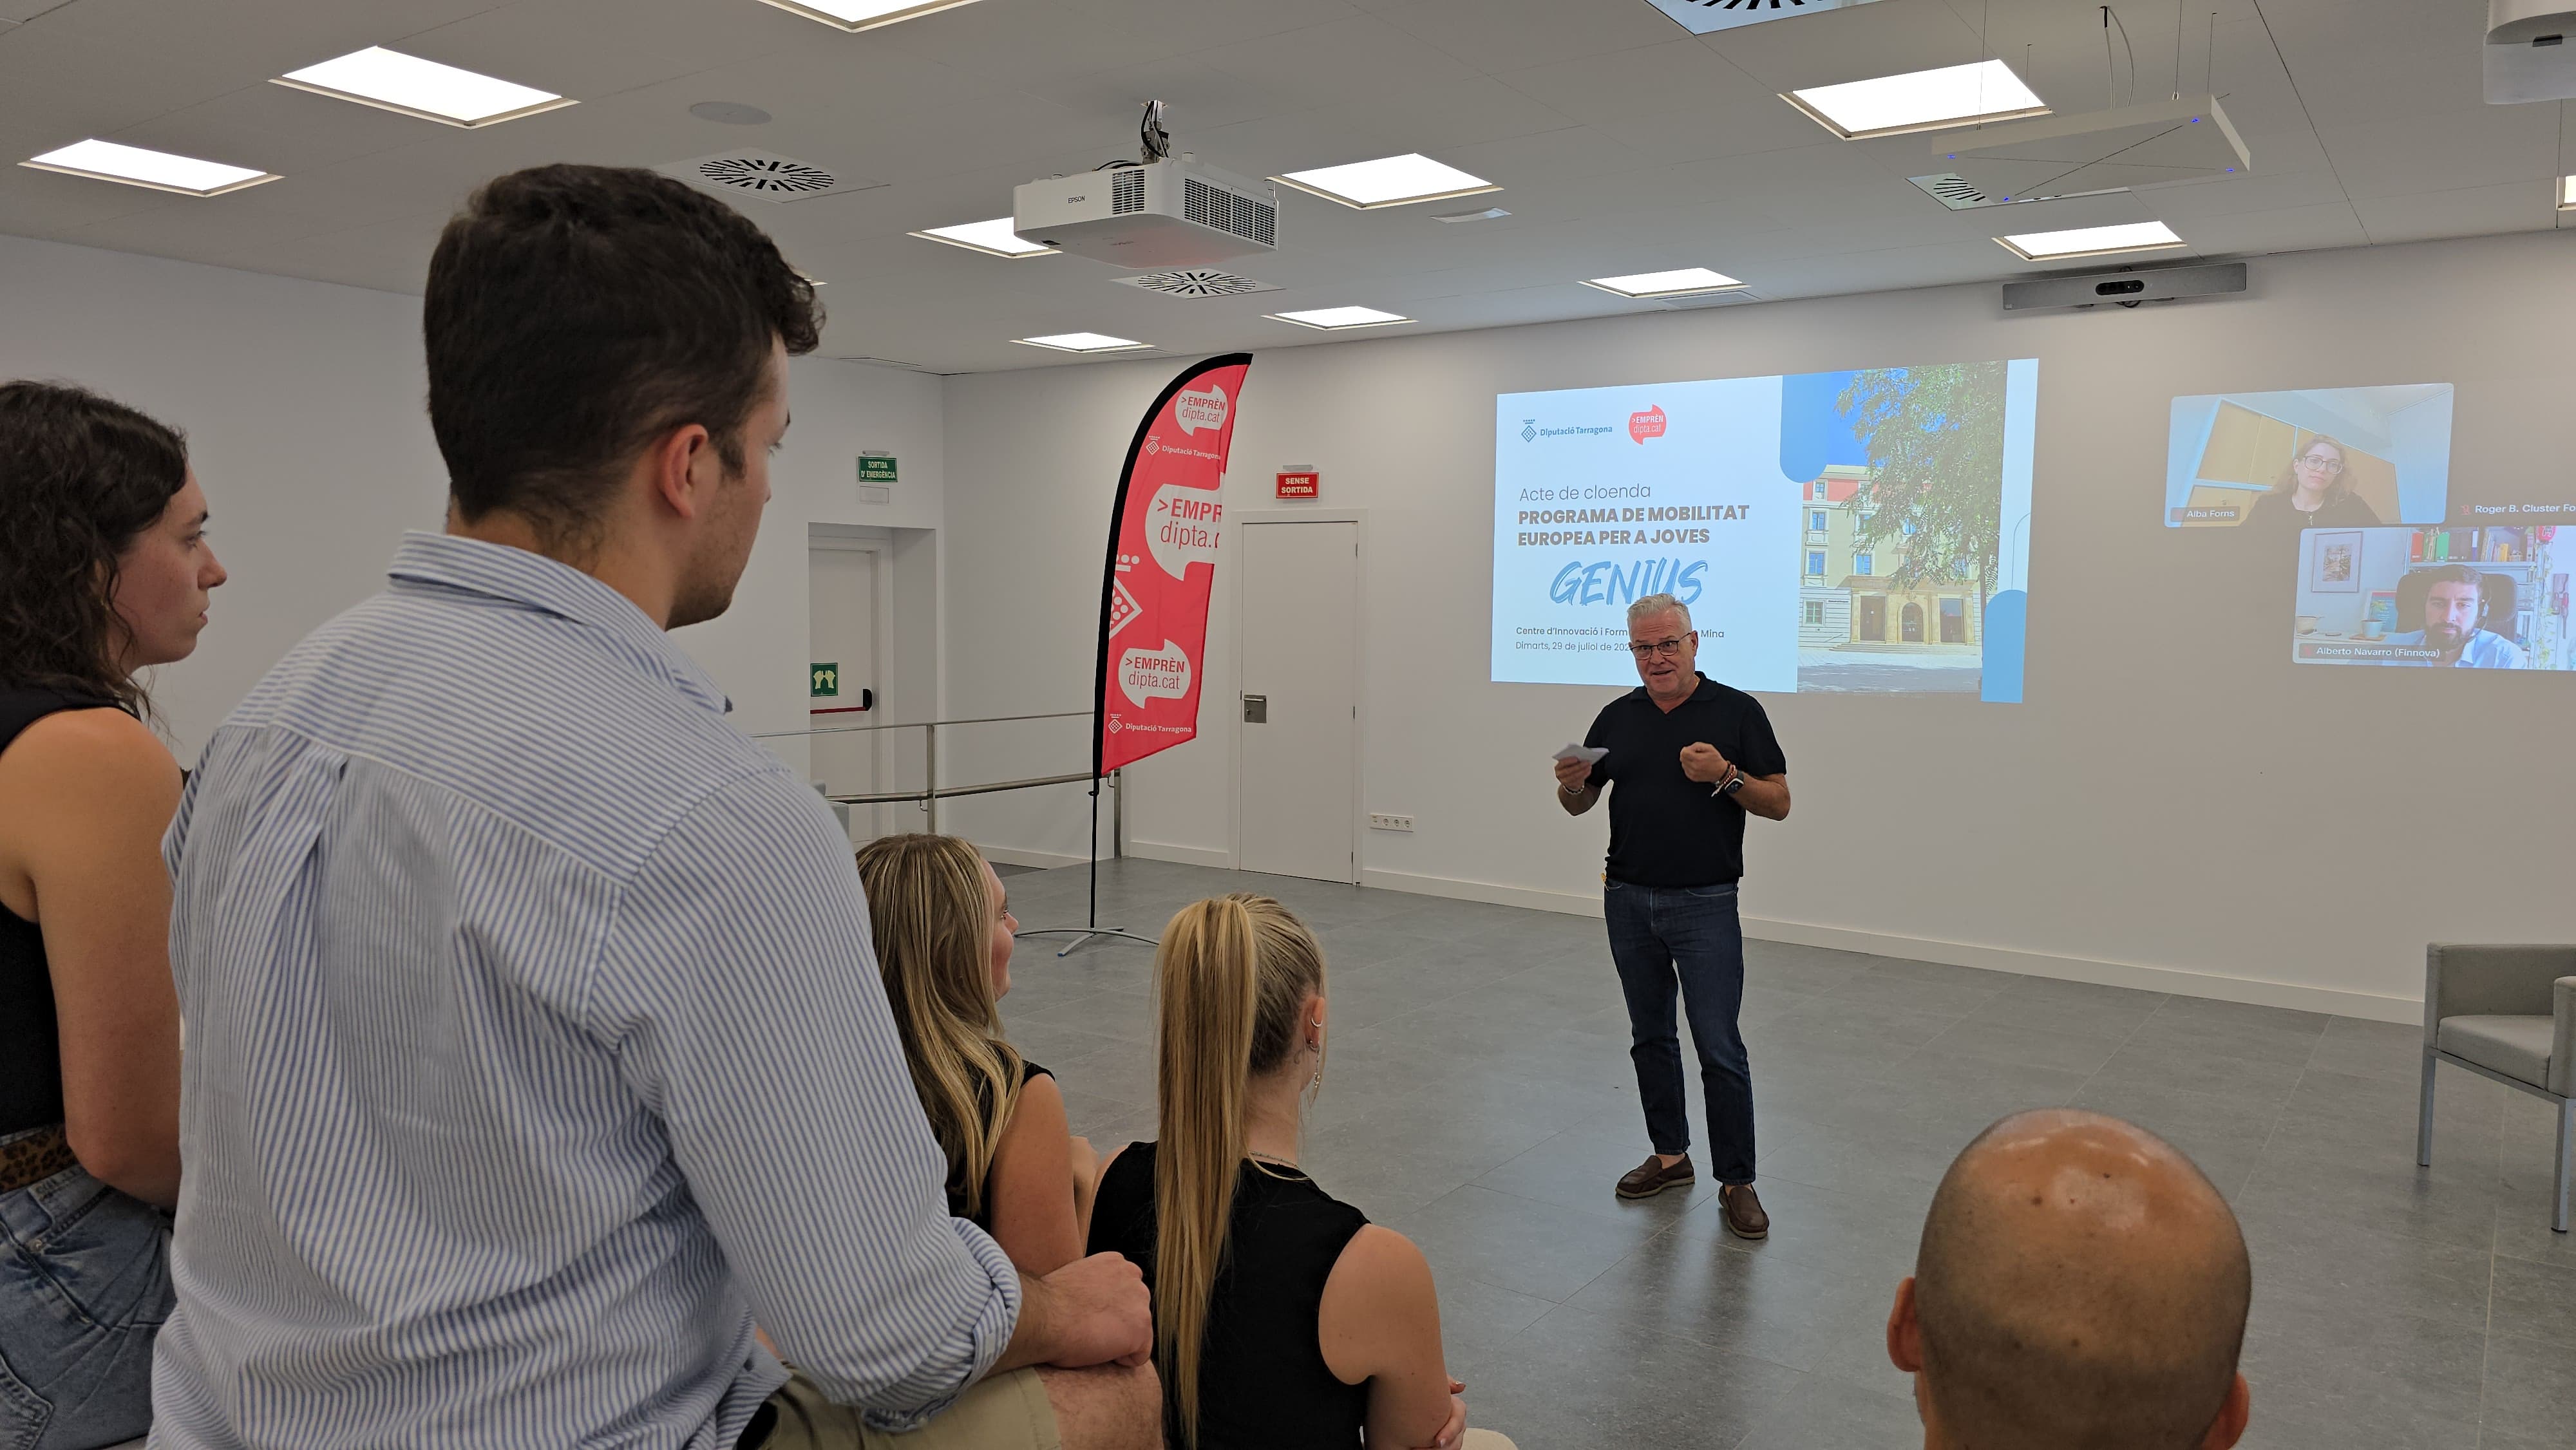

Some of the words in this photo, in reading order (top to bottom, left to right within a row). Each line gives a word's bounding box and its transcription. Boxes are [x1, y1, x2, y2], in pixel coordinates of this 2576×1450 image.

[1068, 195, 1085, 203] EPSON
[1182, 407, 1220, 422] dipta.cat
[1540, 426, 1575, 438] Diputació
[1576, 426, 1613, 437] Tarragona
[1162, 445, 1193, 455] Diputació
[867, 460, 888, 469] SORTIDA
[1519, 487, 1554, 502] Acte
[1558, 485, 1579, 500] de
[1584, 483, 1651, 500] cloenda
[2475, 505, 2506, 514] Roger
[2509, 504, 2519, 513] B.
[2523, 504, 2561, 513] Cluster
[2563, 503, 2576, 512] Fo
[1519, 508, 1618, 525] PROGRAMA
[1622, 507, 1645, 522] DE
[1647, 505, 1750, 522] MOBILITAT
[1518, 531, 1596, 546] EUROPEA
[1599, 529, 1631, 545] PER
[1633, 529, 1647, 544] A
[1650, 529, 1710, 544] JOVES
[1549, 556, 1709, 606] GENIUS
[1516, 627, 1545, 636] Centre
[1605, 628, 1628, 636] Form
[1701, 629, 1725, 639] Mina
[1515, 641, 1550, 651] Dimarts,
[1552, 642, 1562, 650] 29
[1564, 641, 1576, 650] de
[1577, 641, 1598, 653] juliol
[1600, 642, 1612, 651] de
[1614, 643, 1630, 652] 202
[2316, 646, 2351, 655] Alberto
[2354, 647, 2391, 656] Navarro
[2394, 648, 2440, 658] (Finnova)
[1128, 670, 1180, 690] dipta.cat
[1125, 722, 1157, 733] Diputació
[1158, 725, 1192, 734] Tarragona
